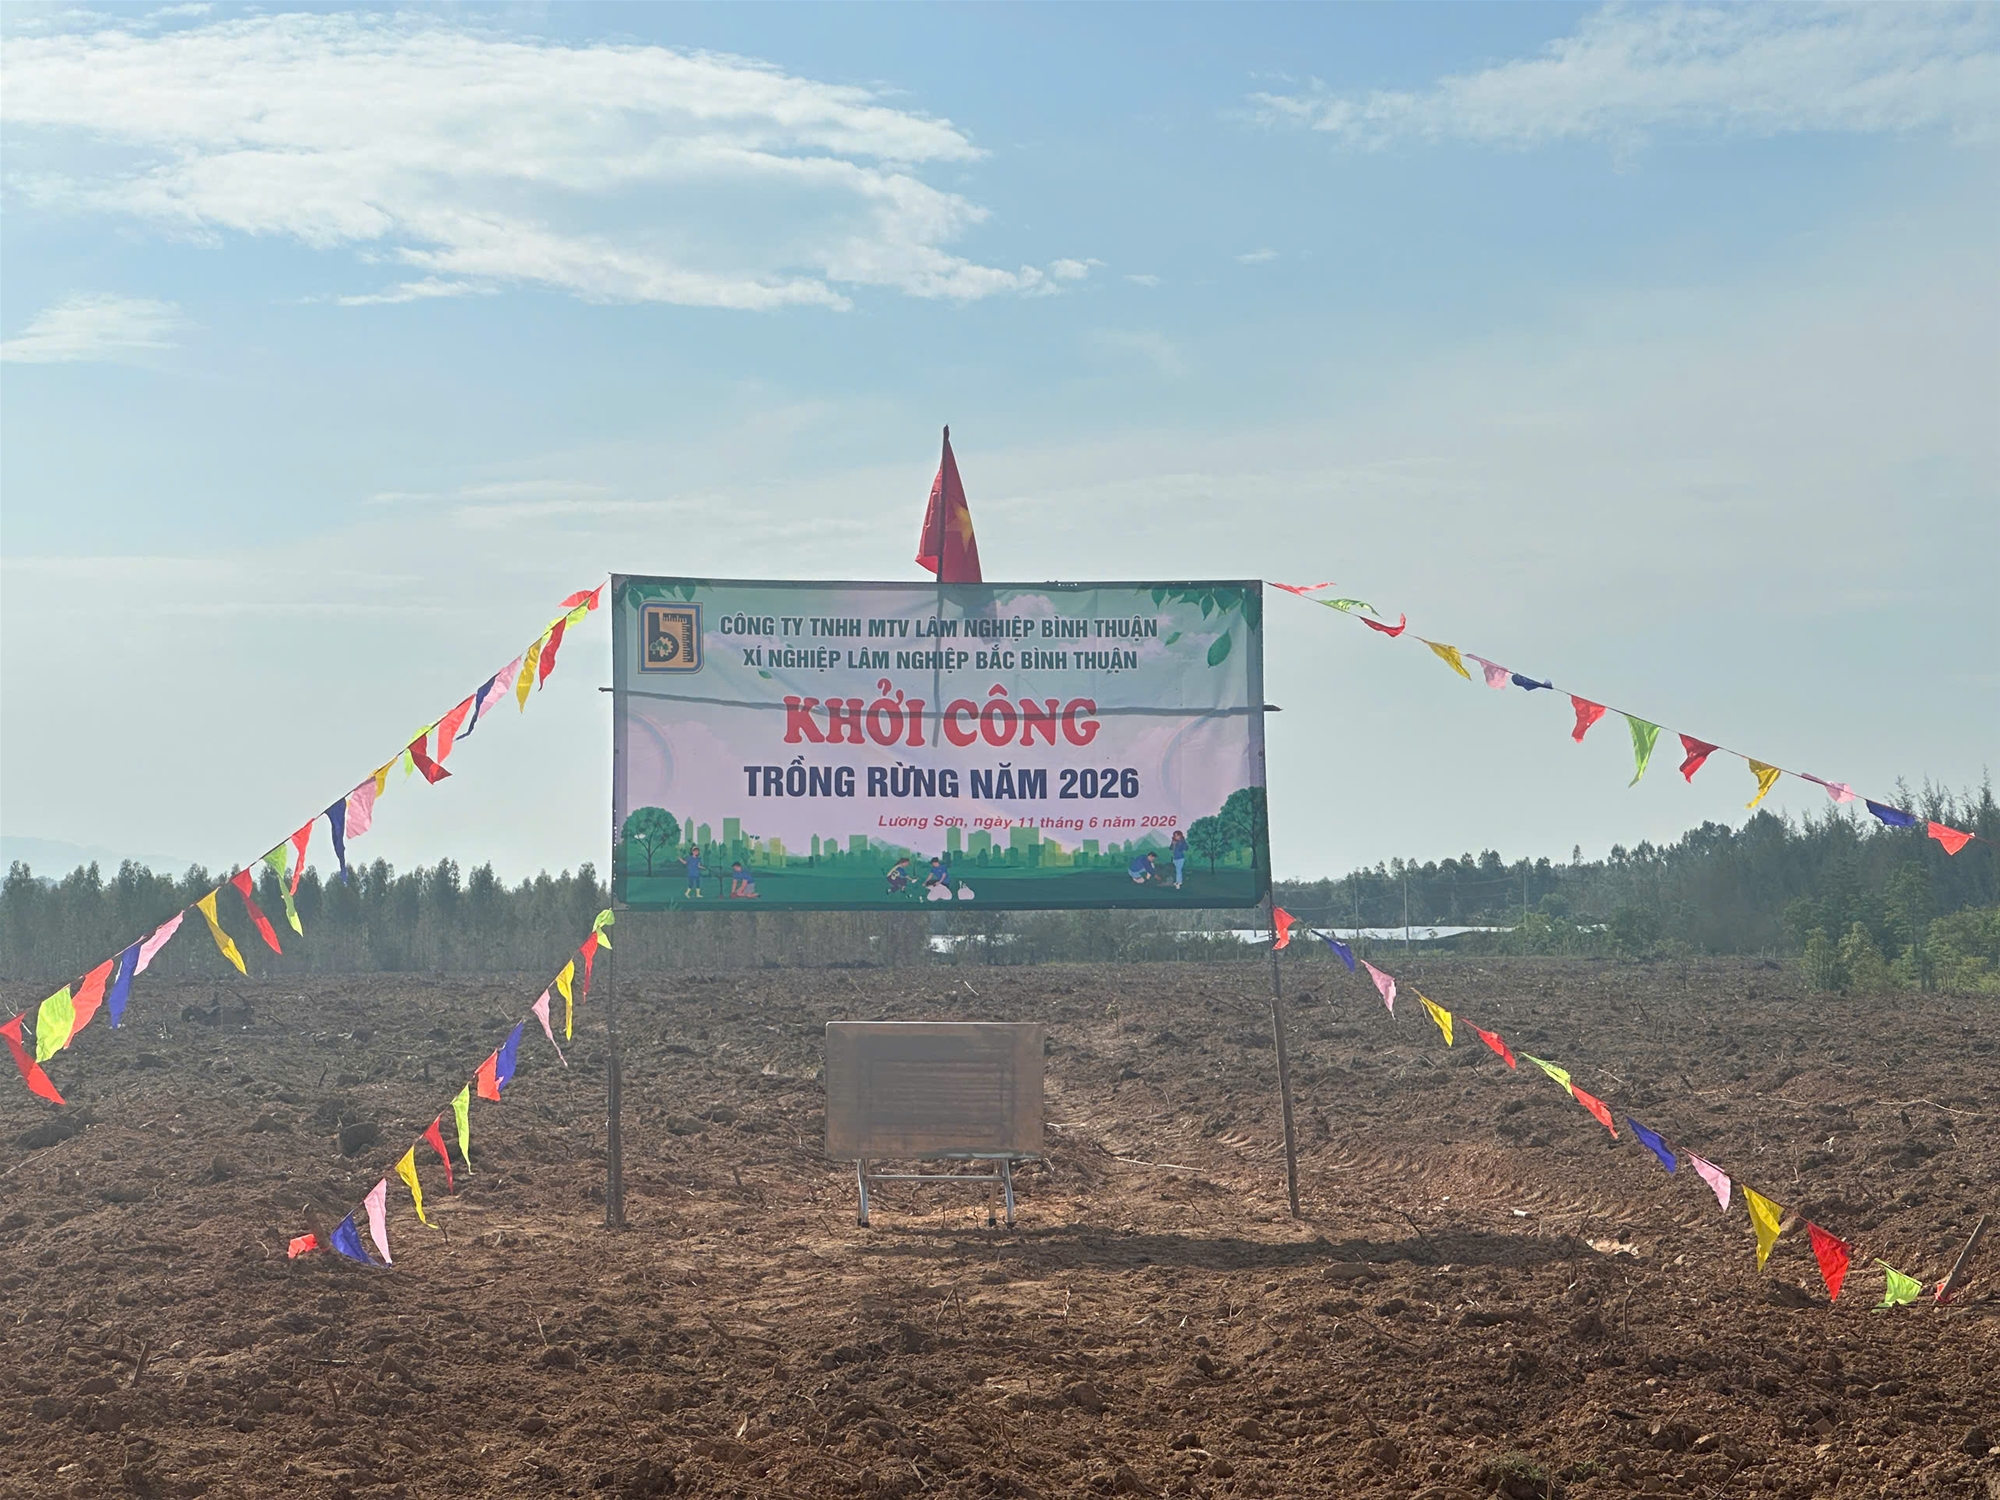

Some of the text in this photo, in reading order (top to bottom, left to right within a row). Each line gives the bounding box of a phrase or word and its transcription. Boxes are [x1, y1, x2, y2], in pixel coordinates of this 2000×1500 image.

[720, 613, 1157, 641] CÔNG TY TNHH MTV LÂM NGHIỆP BÌNH THUẬN
[743, 644, 1137, 673] XÍ NGHIỆP LÂM NGHIỆP BẮC BÌNH THUẬN
[783, 678, 1100, 747] KHỞI CÔNG
[743, 756, 1139, 799] TRỒNG RỪNG NĂM 2026
[878, 815, 1177, 831] Lương Sơn, ngày 11 tháng 6 năm 2026
